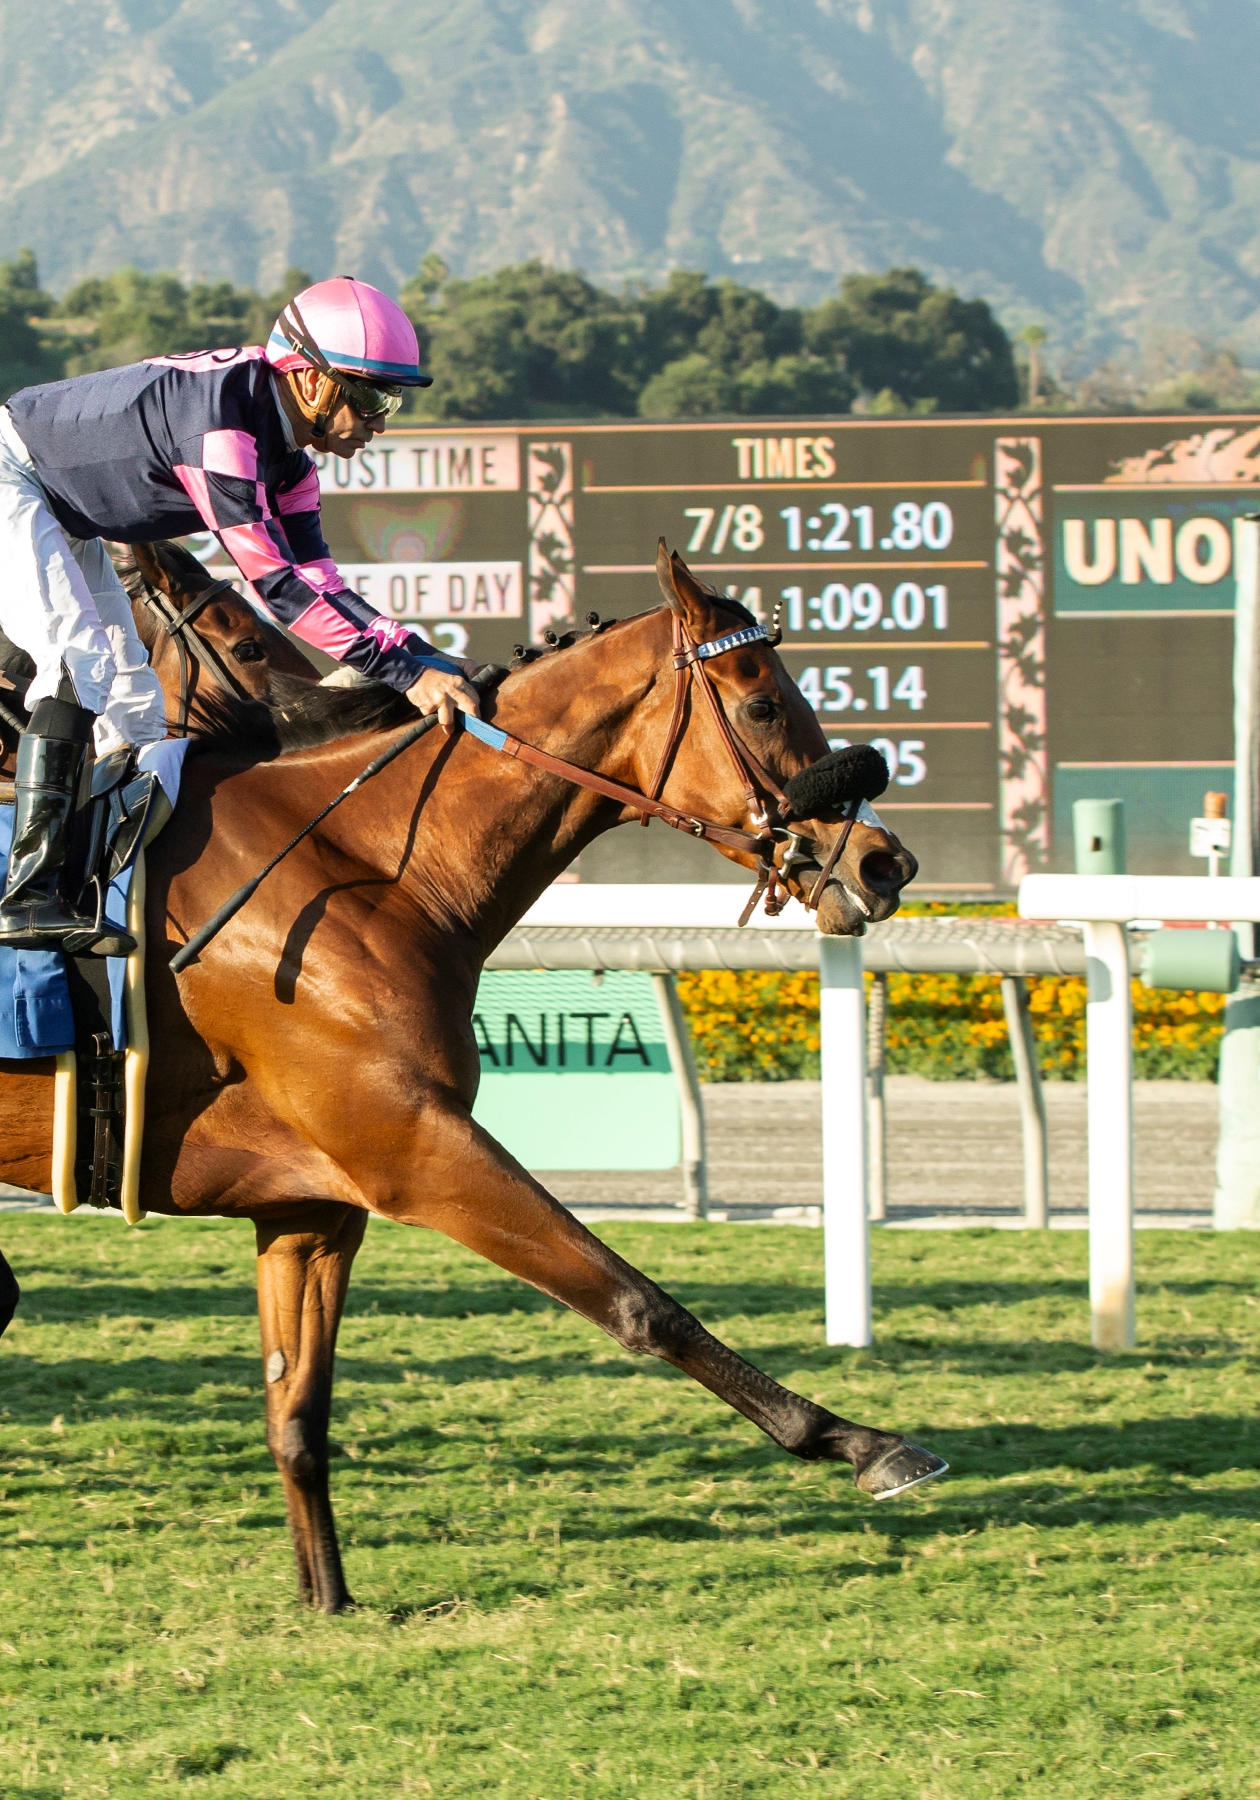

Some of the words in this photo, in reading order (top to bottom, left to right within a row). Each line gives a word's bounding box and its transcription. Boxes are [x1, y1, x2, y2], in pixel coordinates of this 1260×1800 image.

[411, 446, 497, 487] TIME
[731, 436, 837, 480] TIMES
[684, 504, 765, 555] 7/8
[779, 501, 954, 552] 1:21.80
[389, 574, 431, 614] OF
[448, 572, 512, 613] DAY
[781, 582, 949, 632] 1:09.01
[797, 665, 928, 712] 45.14
